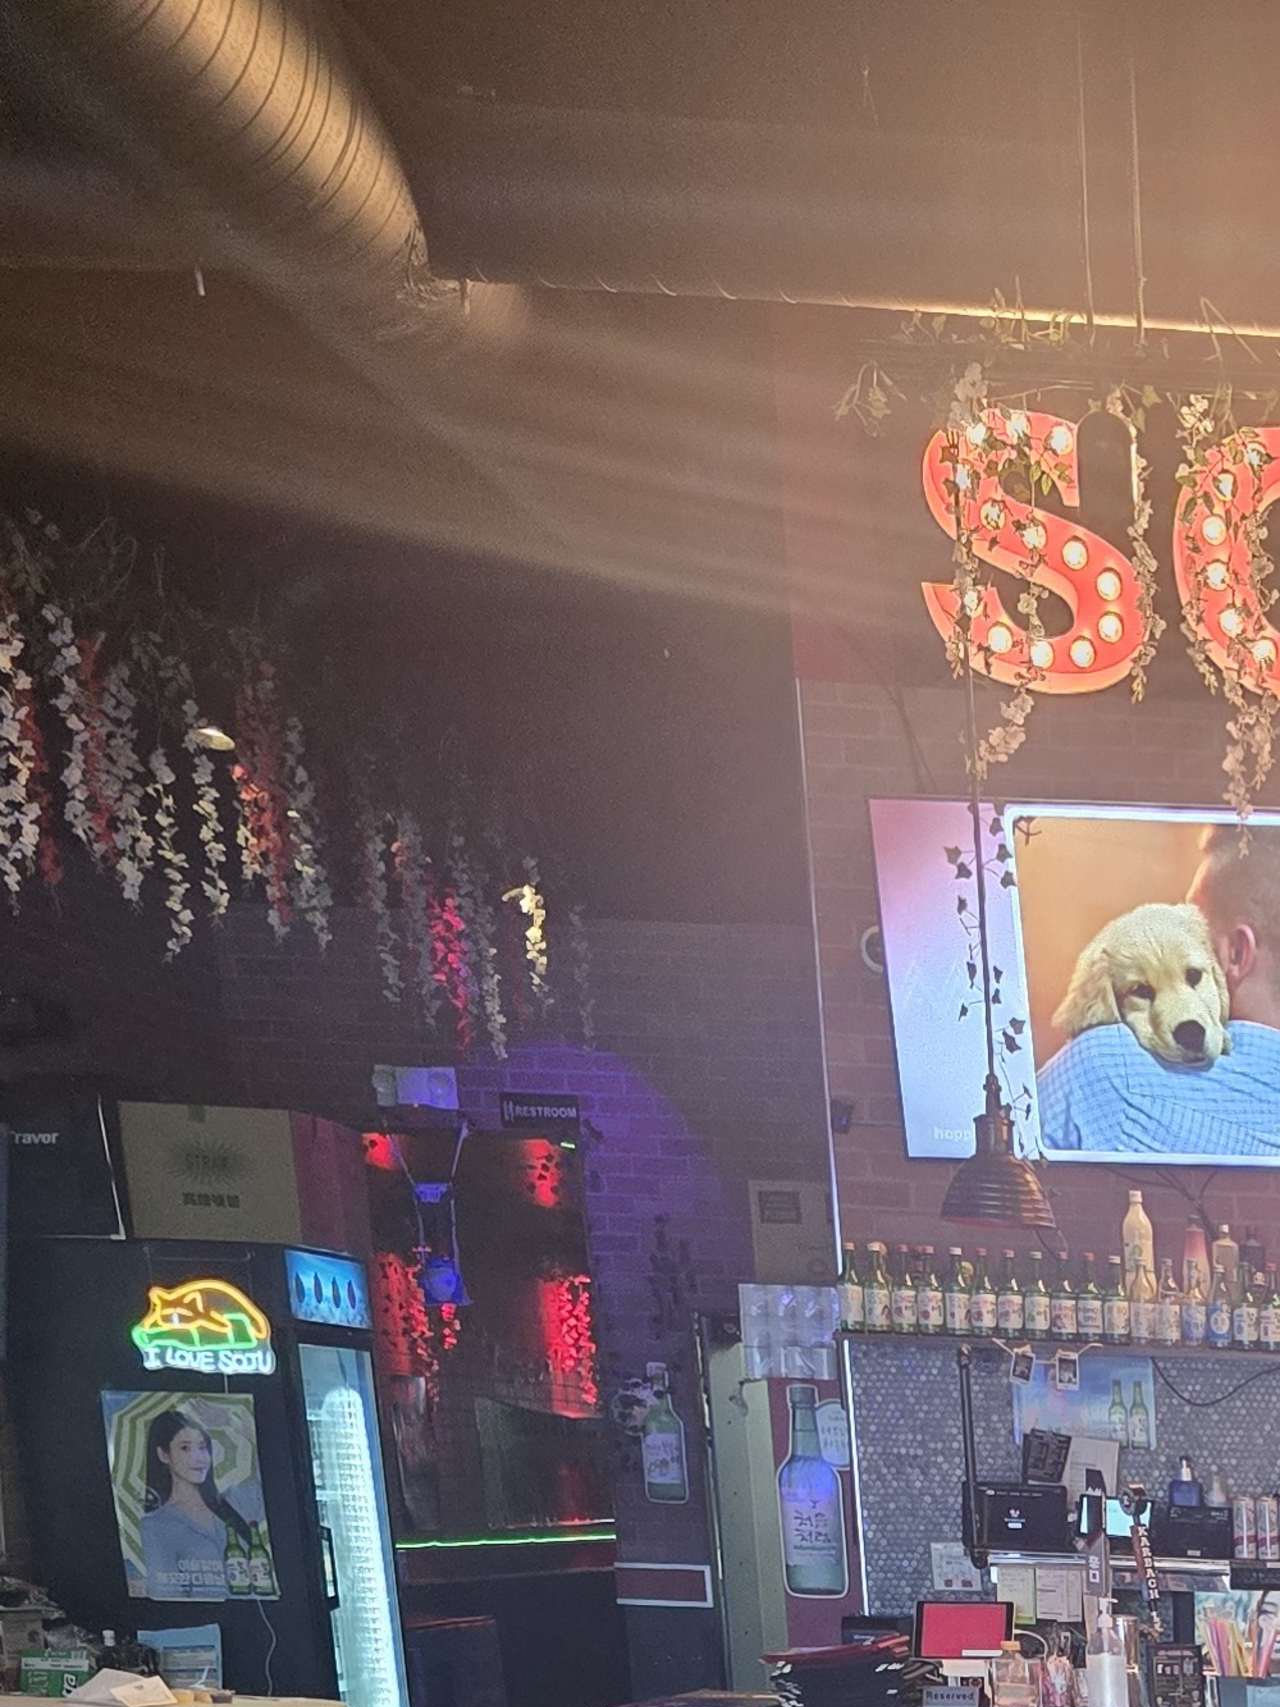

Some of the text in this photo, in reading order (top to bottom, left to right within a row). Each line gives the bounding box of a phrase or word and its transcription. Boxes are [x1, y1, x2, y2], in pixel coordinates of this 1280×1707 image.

[514, 1105, 577, 1118] RESTROOM
[166, 1347, 216, 1372] LOVE
[219, 1350, 275, 1375] SOJU
[1137, 1526, 1160, 1599] KARBACH
